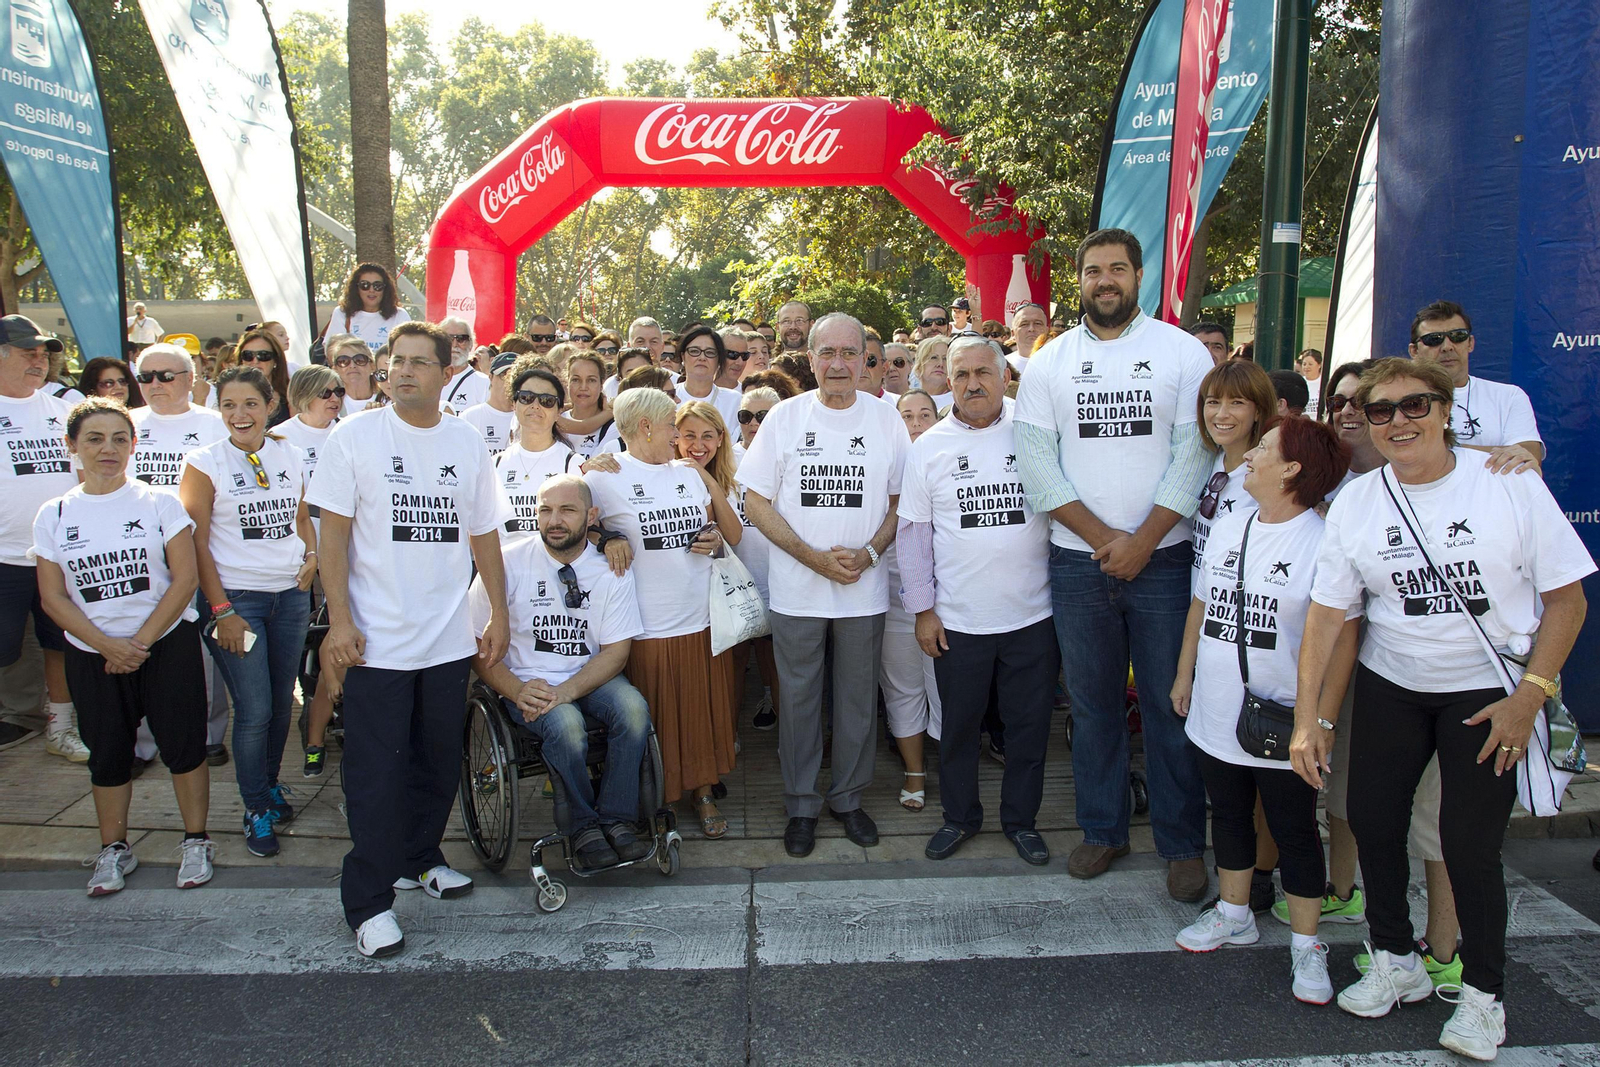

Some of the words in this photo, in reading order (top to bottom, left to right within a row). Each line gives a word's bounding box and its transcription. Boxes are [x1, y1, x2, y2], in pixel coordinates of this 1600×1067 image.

[1134, 72, 1258, 102] Ayunento
[1132, 112, 1153, 129] de
[634, 101, 852, 167] Coca-Cola
[1122, 149, 1154, 165] Área
[1158, 150, 1170, 162] de
[479, 130, 567, 224] Coca-Cola
[1077, 390, 1152, 405] CAMINATA
[1077, 405, 1152, 420] SOLIDARIA
[1098, 422, 1132, 437] 2014
[7, 438, 64, 450] CAMINAT
[11, 449, 69, 462] SOLIDARI
[135, 452, 184, 462] CAMINA
[32, 462, 62, 473] 2014
[136, 463, 181, 473] SOLIDA
[800, 465, 865, 477] CAMINATA
[150, 474, 181, 485] 2014
[800, 479, 864, 491] SOLIDARIA
[956, 482, 1024, 500] CAMINATA
[238, 498, 297, 515] CAMINATA
[816, 494, 846, 506] 2014
[959, 497, 1024, 513] SOLIDARIA
[392, 509, 459, 524] SOLIDARIA
[638, 505, 702, 523] CAMINATA
[977, 512, 1009, 526] 2014
[518, 520, 538, 530] 201
[641, 518, 702, 536] SOLIDARIA
[410, 527, 442, 541] 2014
[662, 534, 690, 549] 2014
[68, 548, 148, 572] CAMINATA
[76, 562, 149, 587] SOLIDARIA
[1391, 560, 1481, 586] CAMATA
[98, 581, 134, 599] 2014
[1211, 586, 1278, 613] CAMNATA
[1426, 596, 1459, 614] 201
[532, 615, 588, 630] CAMINTA
[533, 629, 585, 640] SOLIDAA
[1218, 625, 1253, 645] 204
[552, 643, 581, 655] 2014
